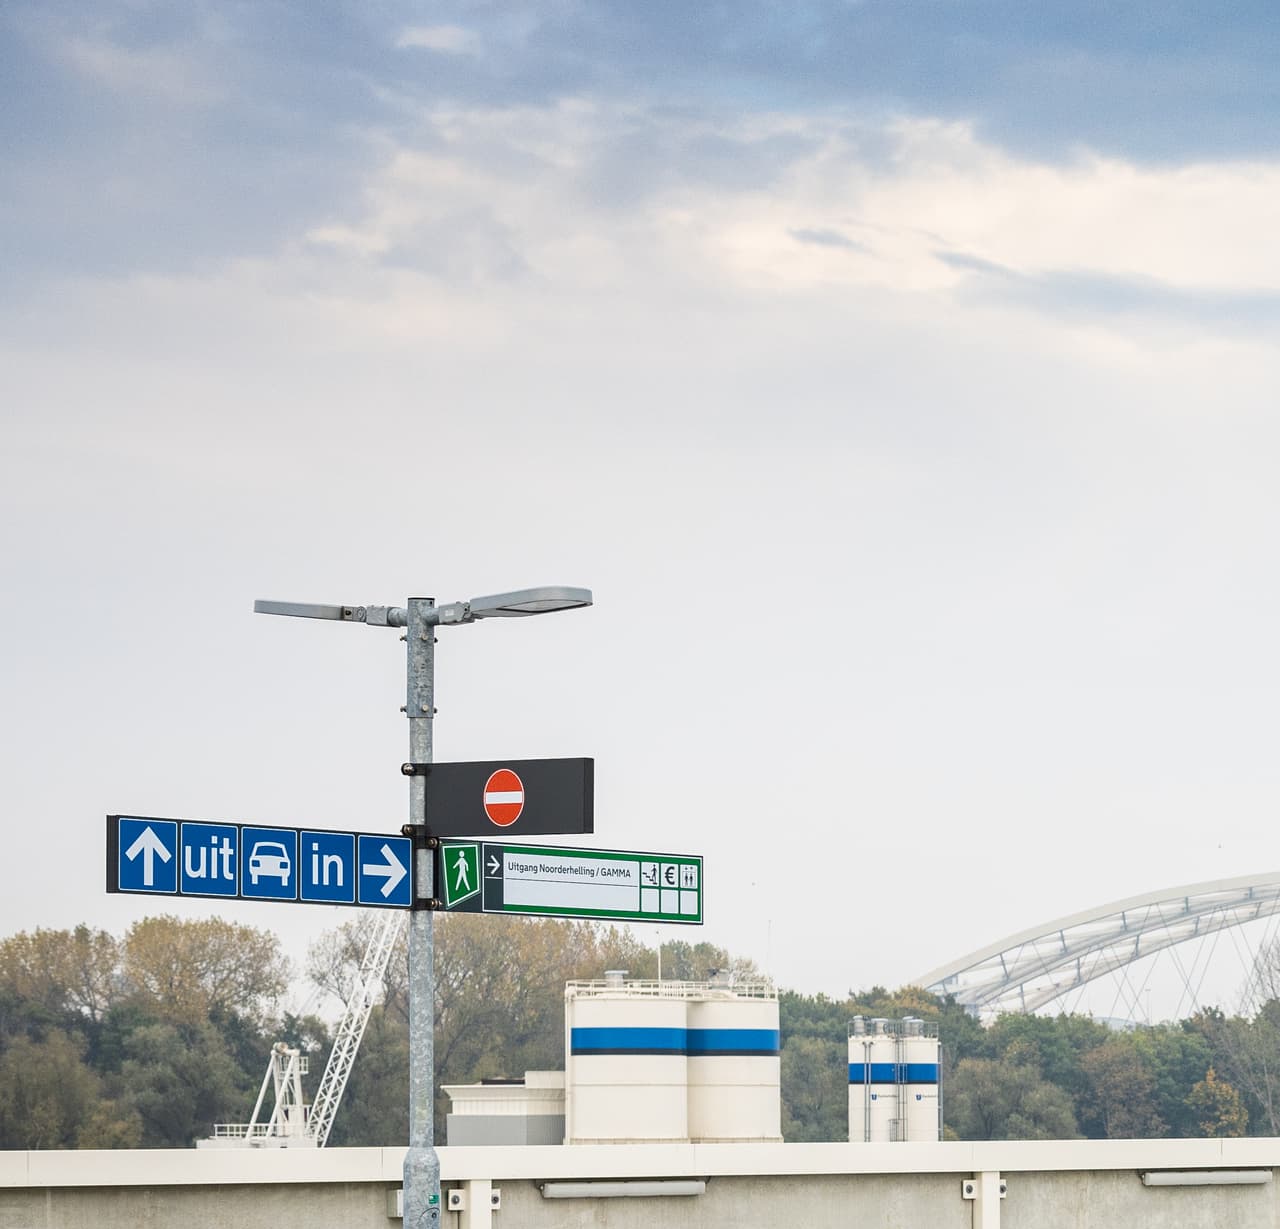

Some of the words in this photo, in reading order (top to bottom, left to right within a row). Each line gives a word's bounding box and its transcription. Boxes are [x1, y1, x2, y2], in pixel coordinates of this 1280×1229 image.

[184, 834, 234, 881] uit
[312, 842, 344, 887] in
[508, 861, 538, 875] Uitgang
[539, 863, 595, 878] Noorderhelling
[600, 867, 632, 879] GAMMA
